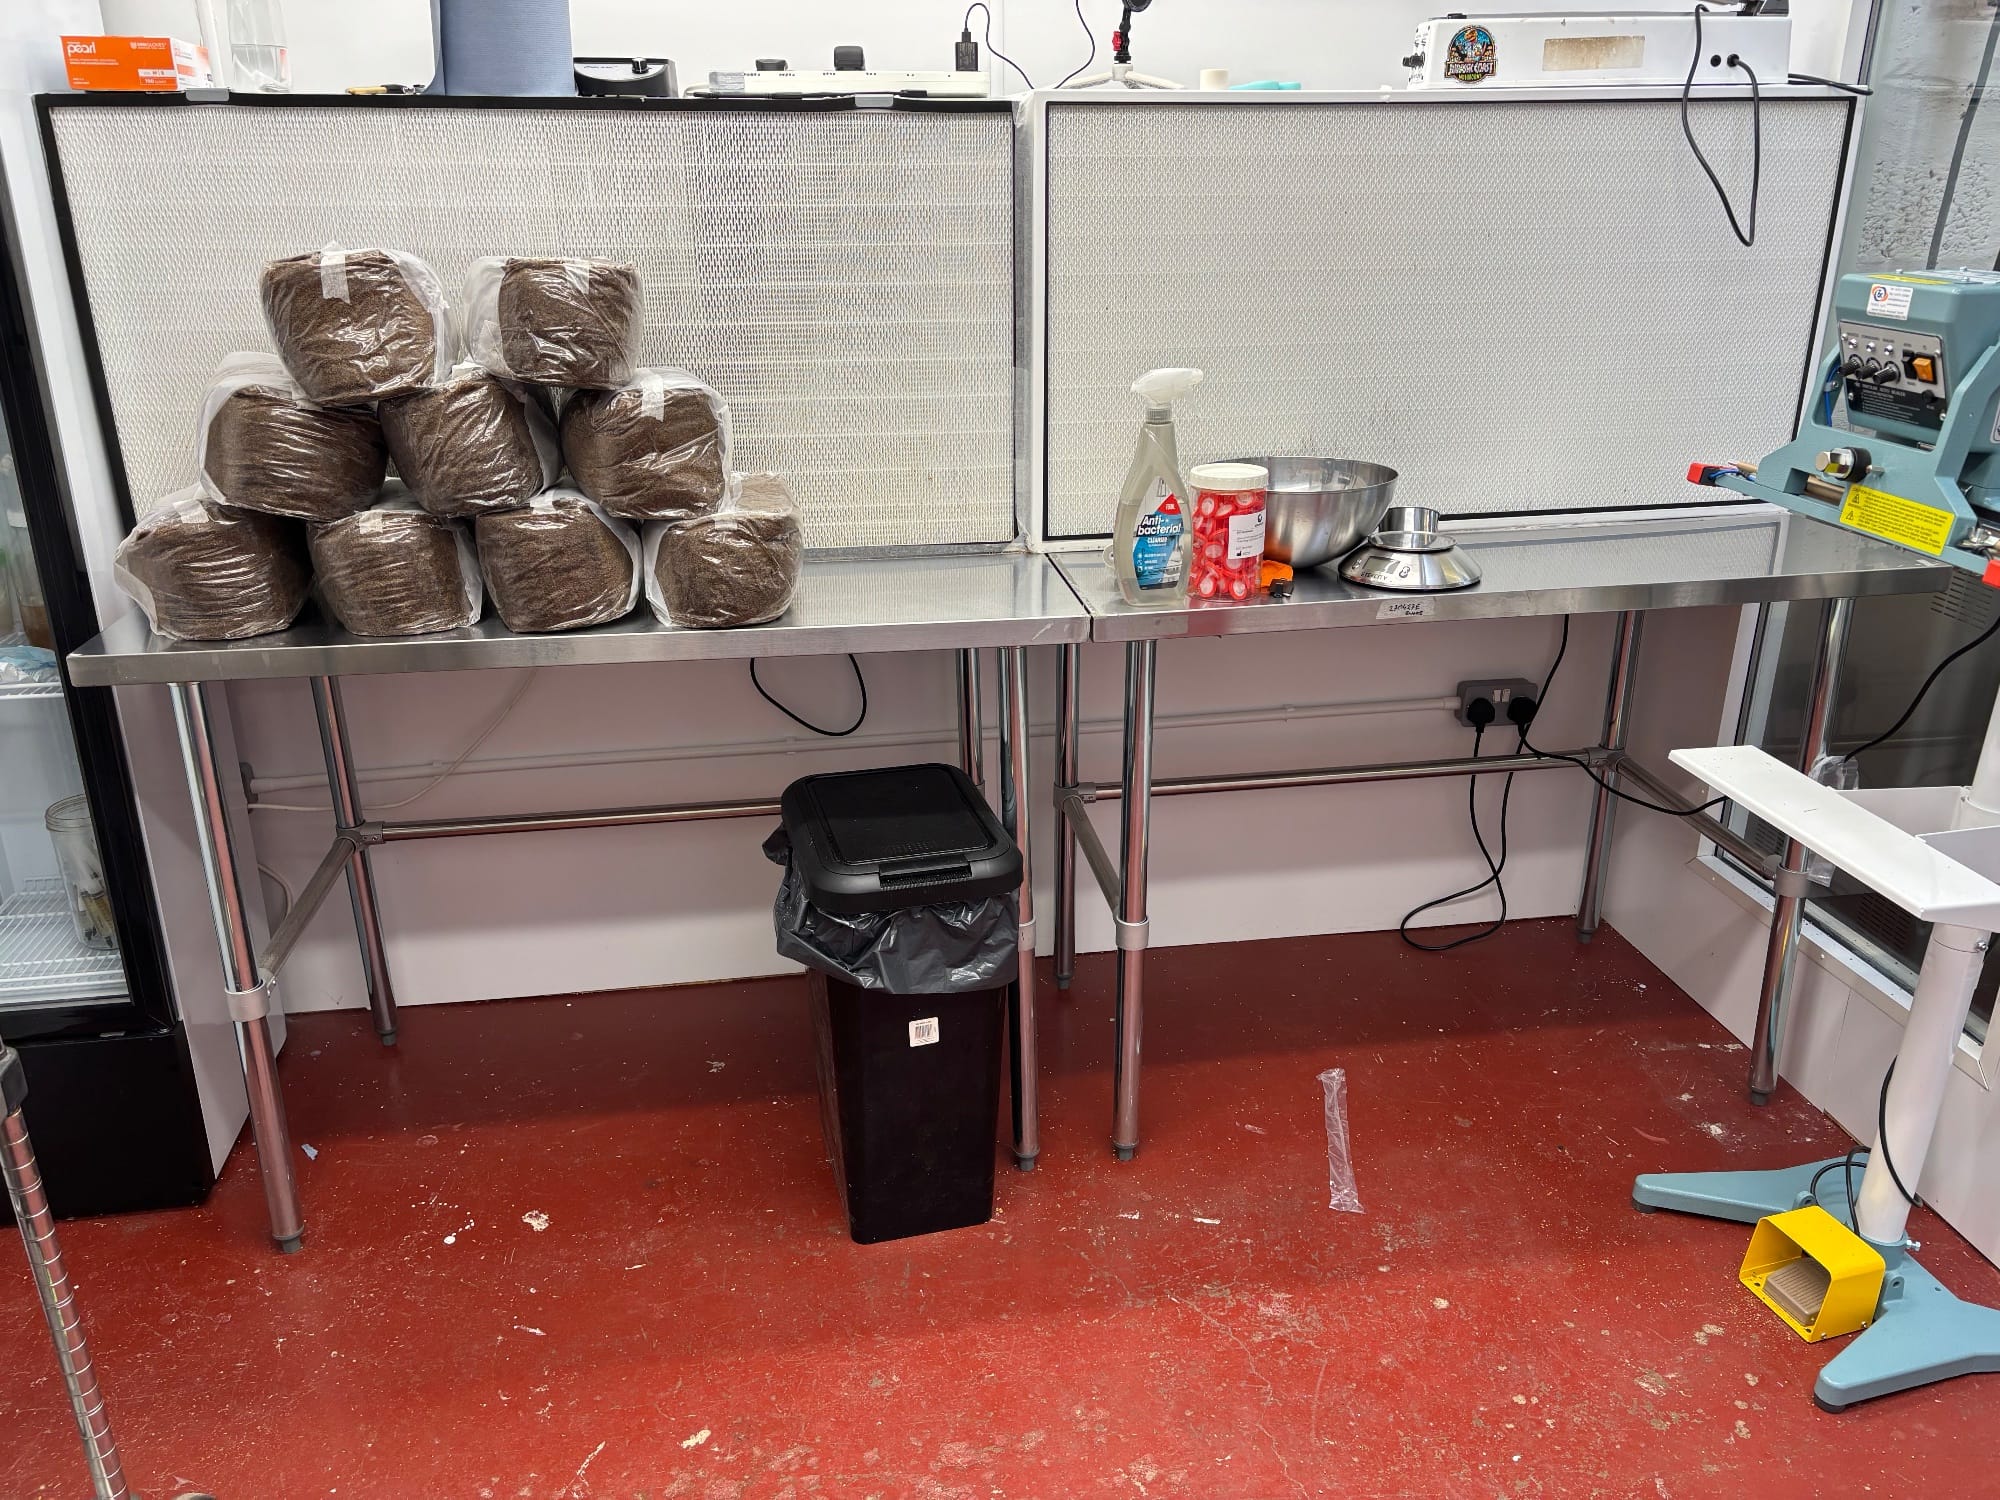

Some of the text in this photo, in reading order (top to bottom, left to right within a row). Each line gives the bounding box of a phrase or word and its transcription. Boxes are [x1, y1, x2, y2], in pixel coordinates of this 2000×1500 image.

[66, 42, 96, 57] pearl
[1142, 515, 1164, 526] Anti-
[1137, 523, 1182, 536] bacterial
